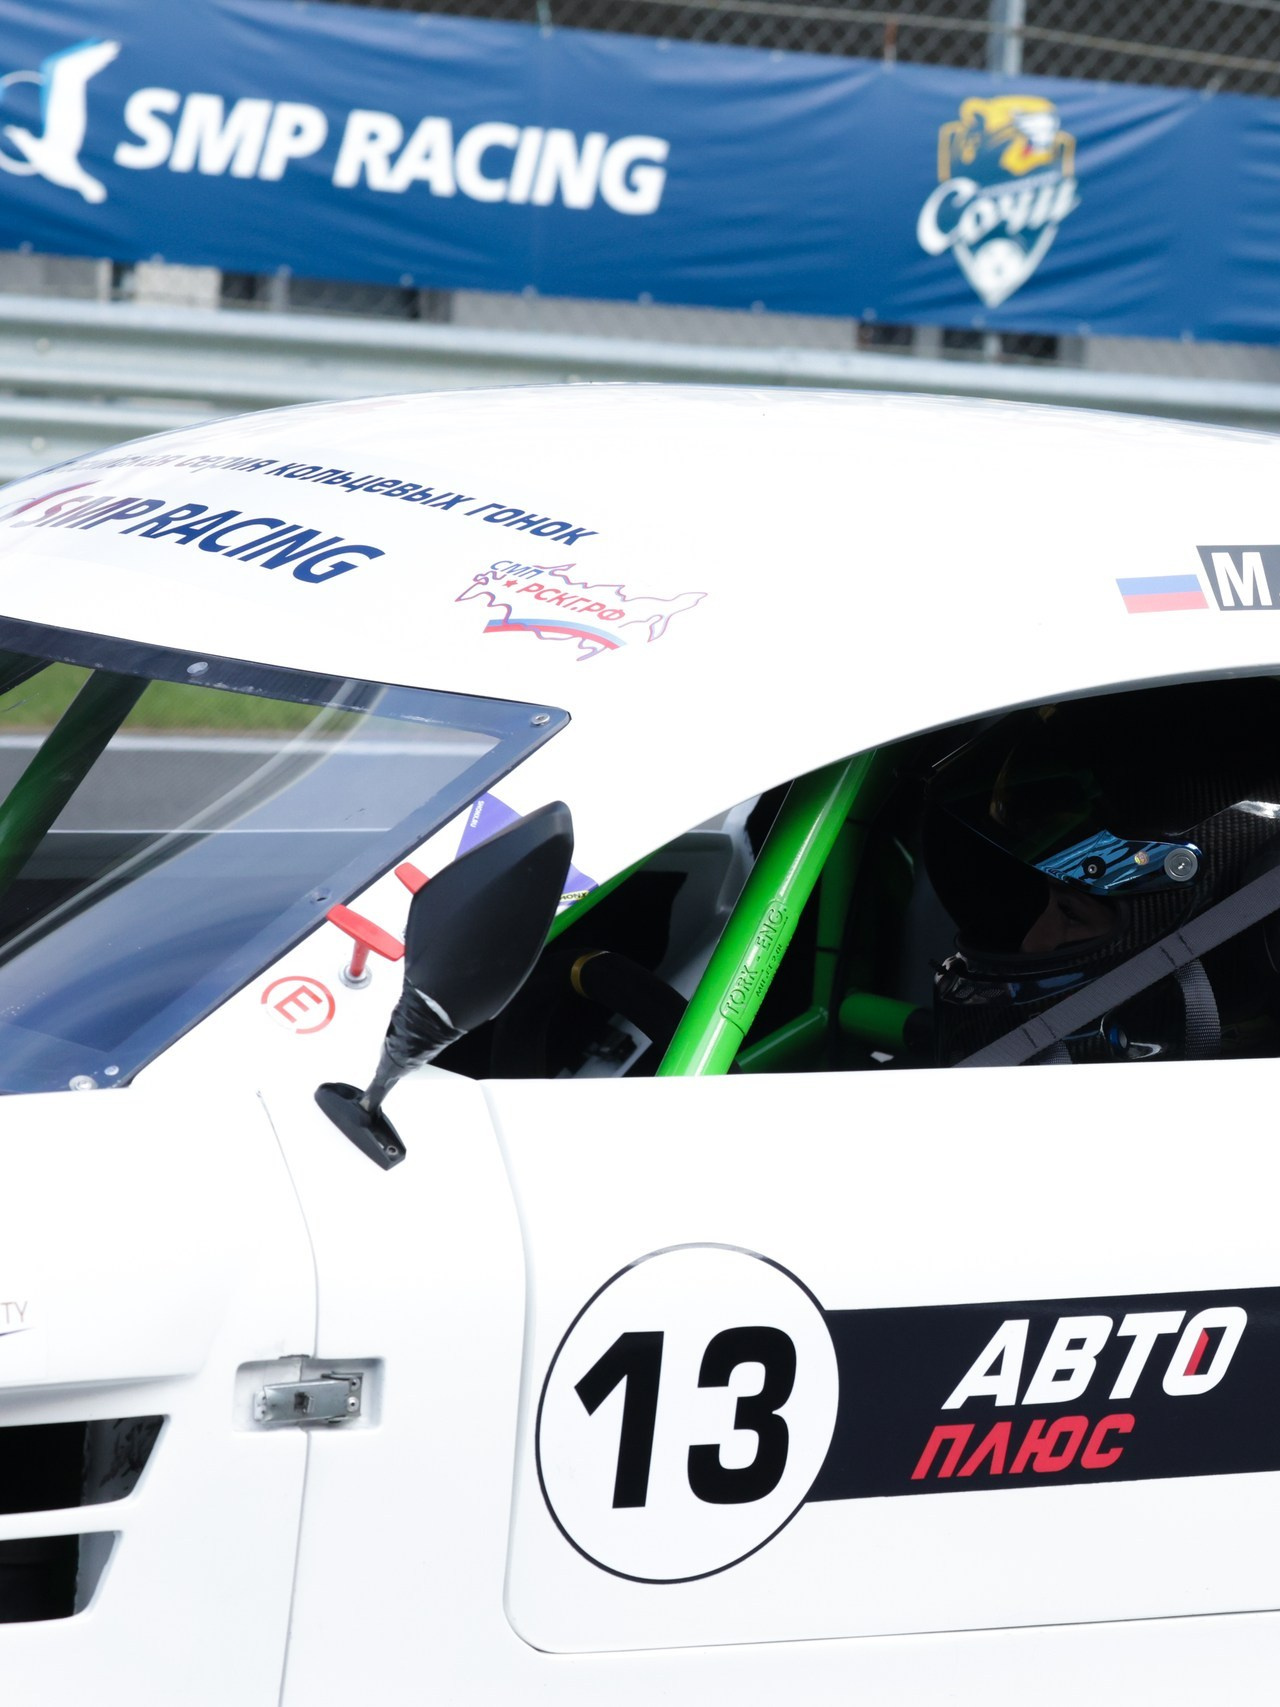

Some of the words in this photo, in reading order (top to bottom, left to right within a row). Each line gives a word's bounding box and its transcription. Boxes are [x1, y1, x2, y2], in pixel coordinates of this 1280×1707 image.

[114, 88, 328, 181] SMP
[333, 110, 670, 215] RACING
[9, 495, 166, 530] SMP
[118, 502, 386, 584] RACING
[265, 462, 476, 511] кольцевых
[464, 502, 599, 546] гонок
[490, 560, 544, 579] СМП
[515, 582, 626, 621] РСКГ.РФ
[726, 965, 758, 1014] TORK
[942, 1306, 1247, 1410] АВТО
[574, 1326, 797, 1509] 13
[911, 1413, 1134, 1480] ПЛЮС
